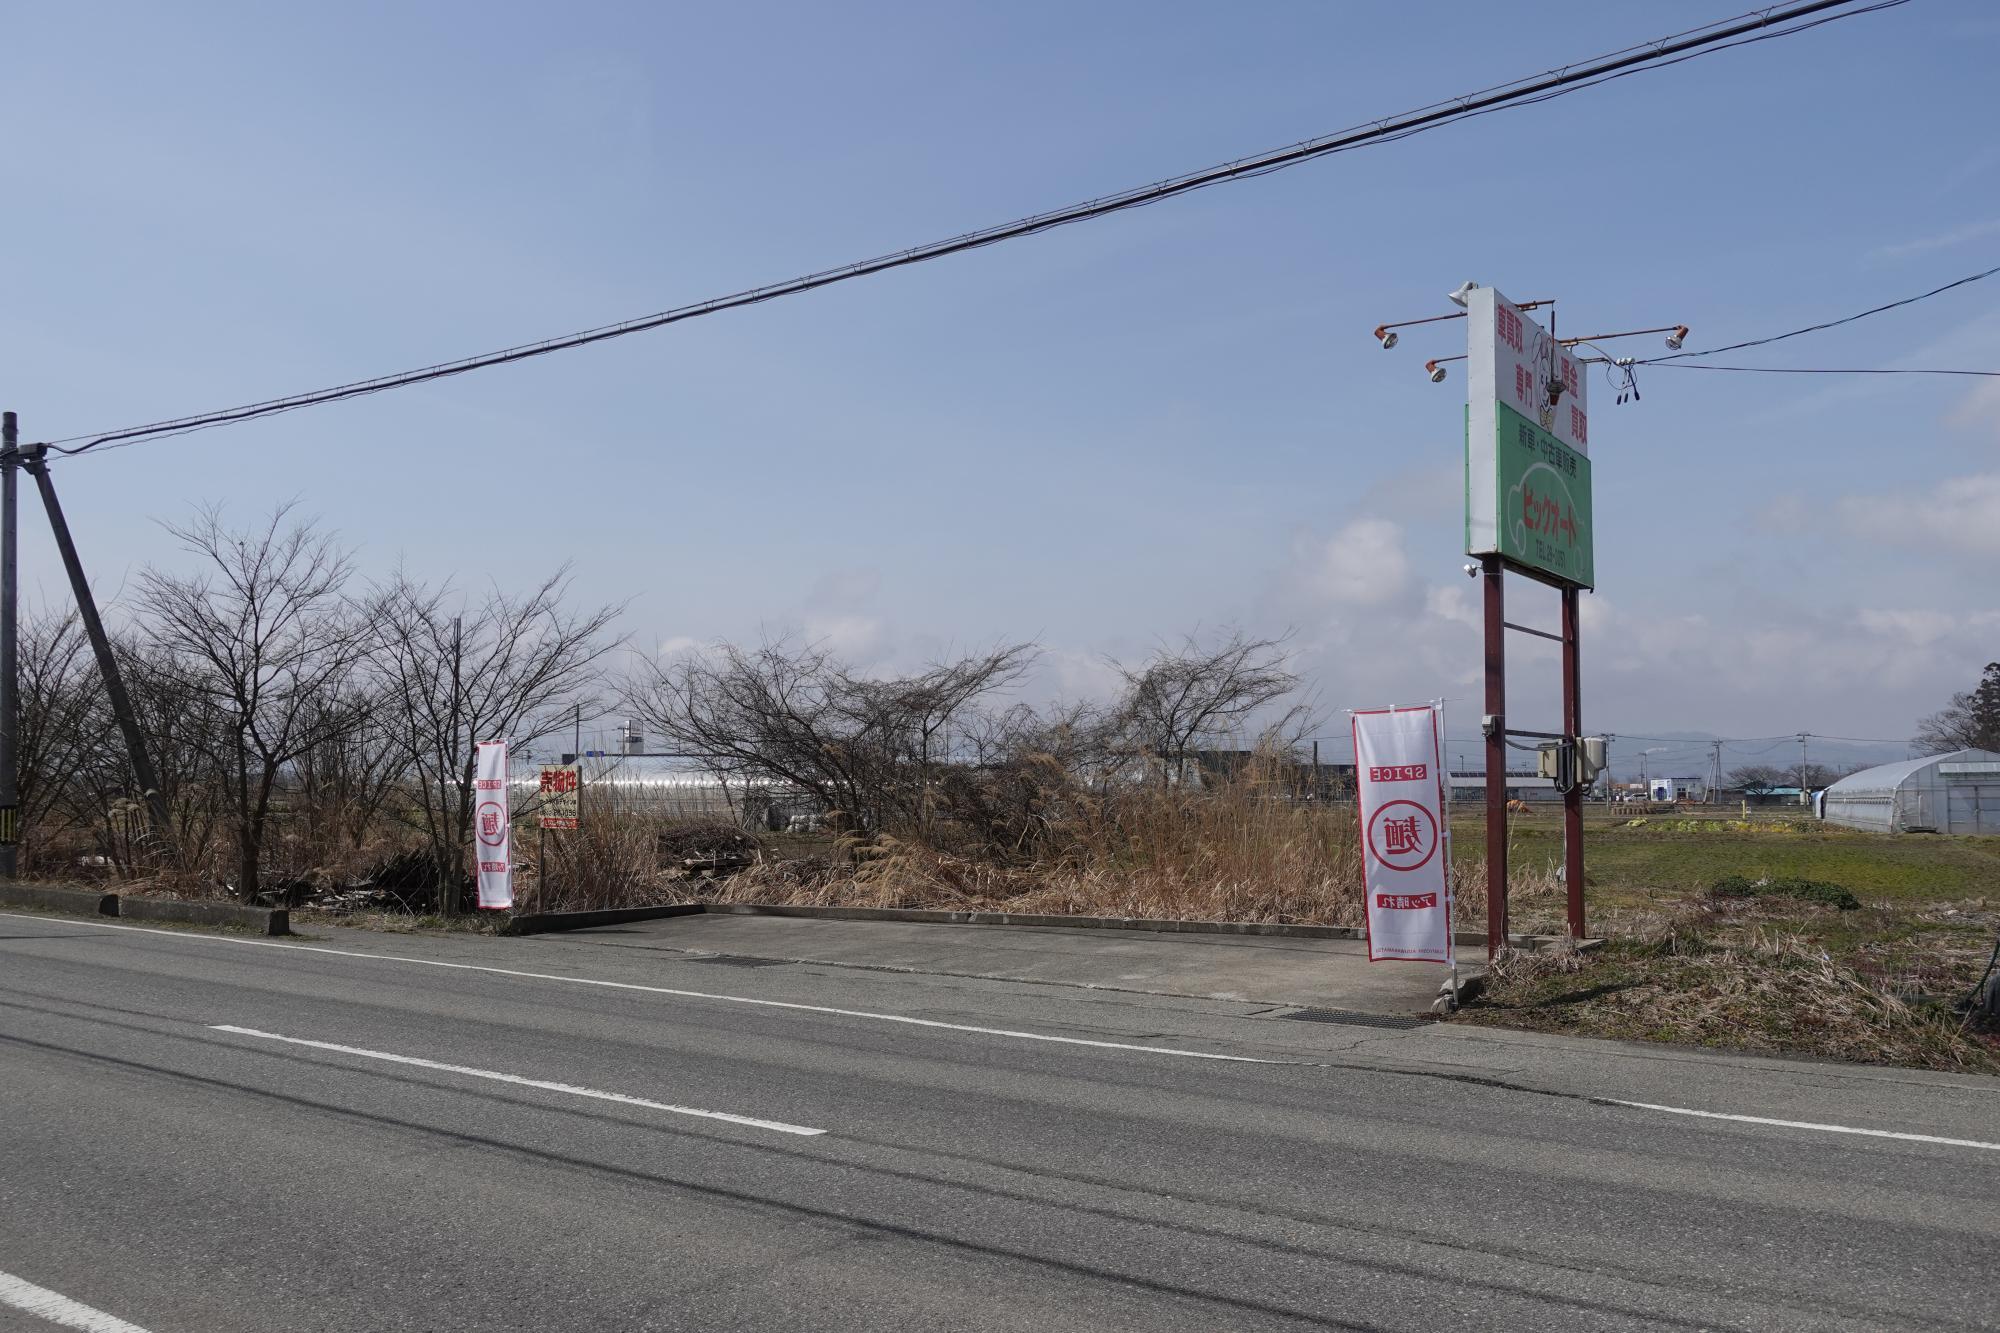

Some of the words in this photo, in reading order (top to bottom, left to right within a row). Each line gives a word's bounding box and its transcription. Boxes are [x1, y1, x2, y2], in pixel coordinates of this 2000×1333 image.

[1497, 303, 1523, 353] 車買取
[1515, 363, 1533, 408] 専門
[1571, 403, 1587, 444] 買取
[541, 770, 577, 792] 売物件
